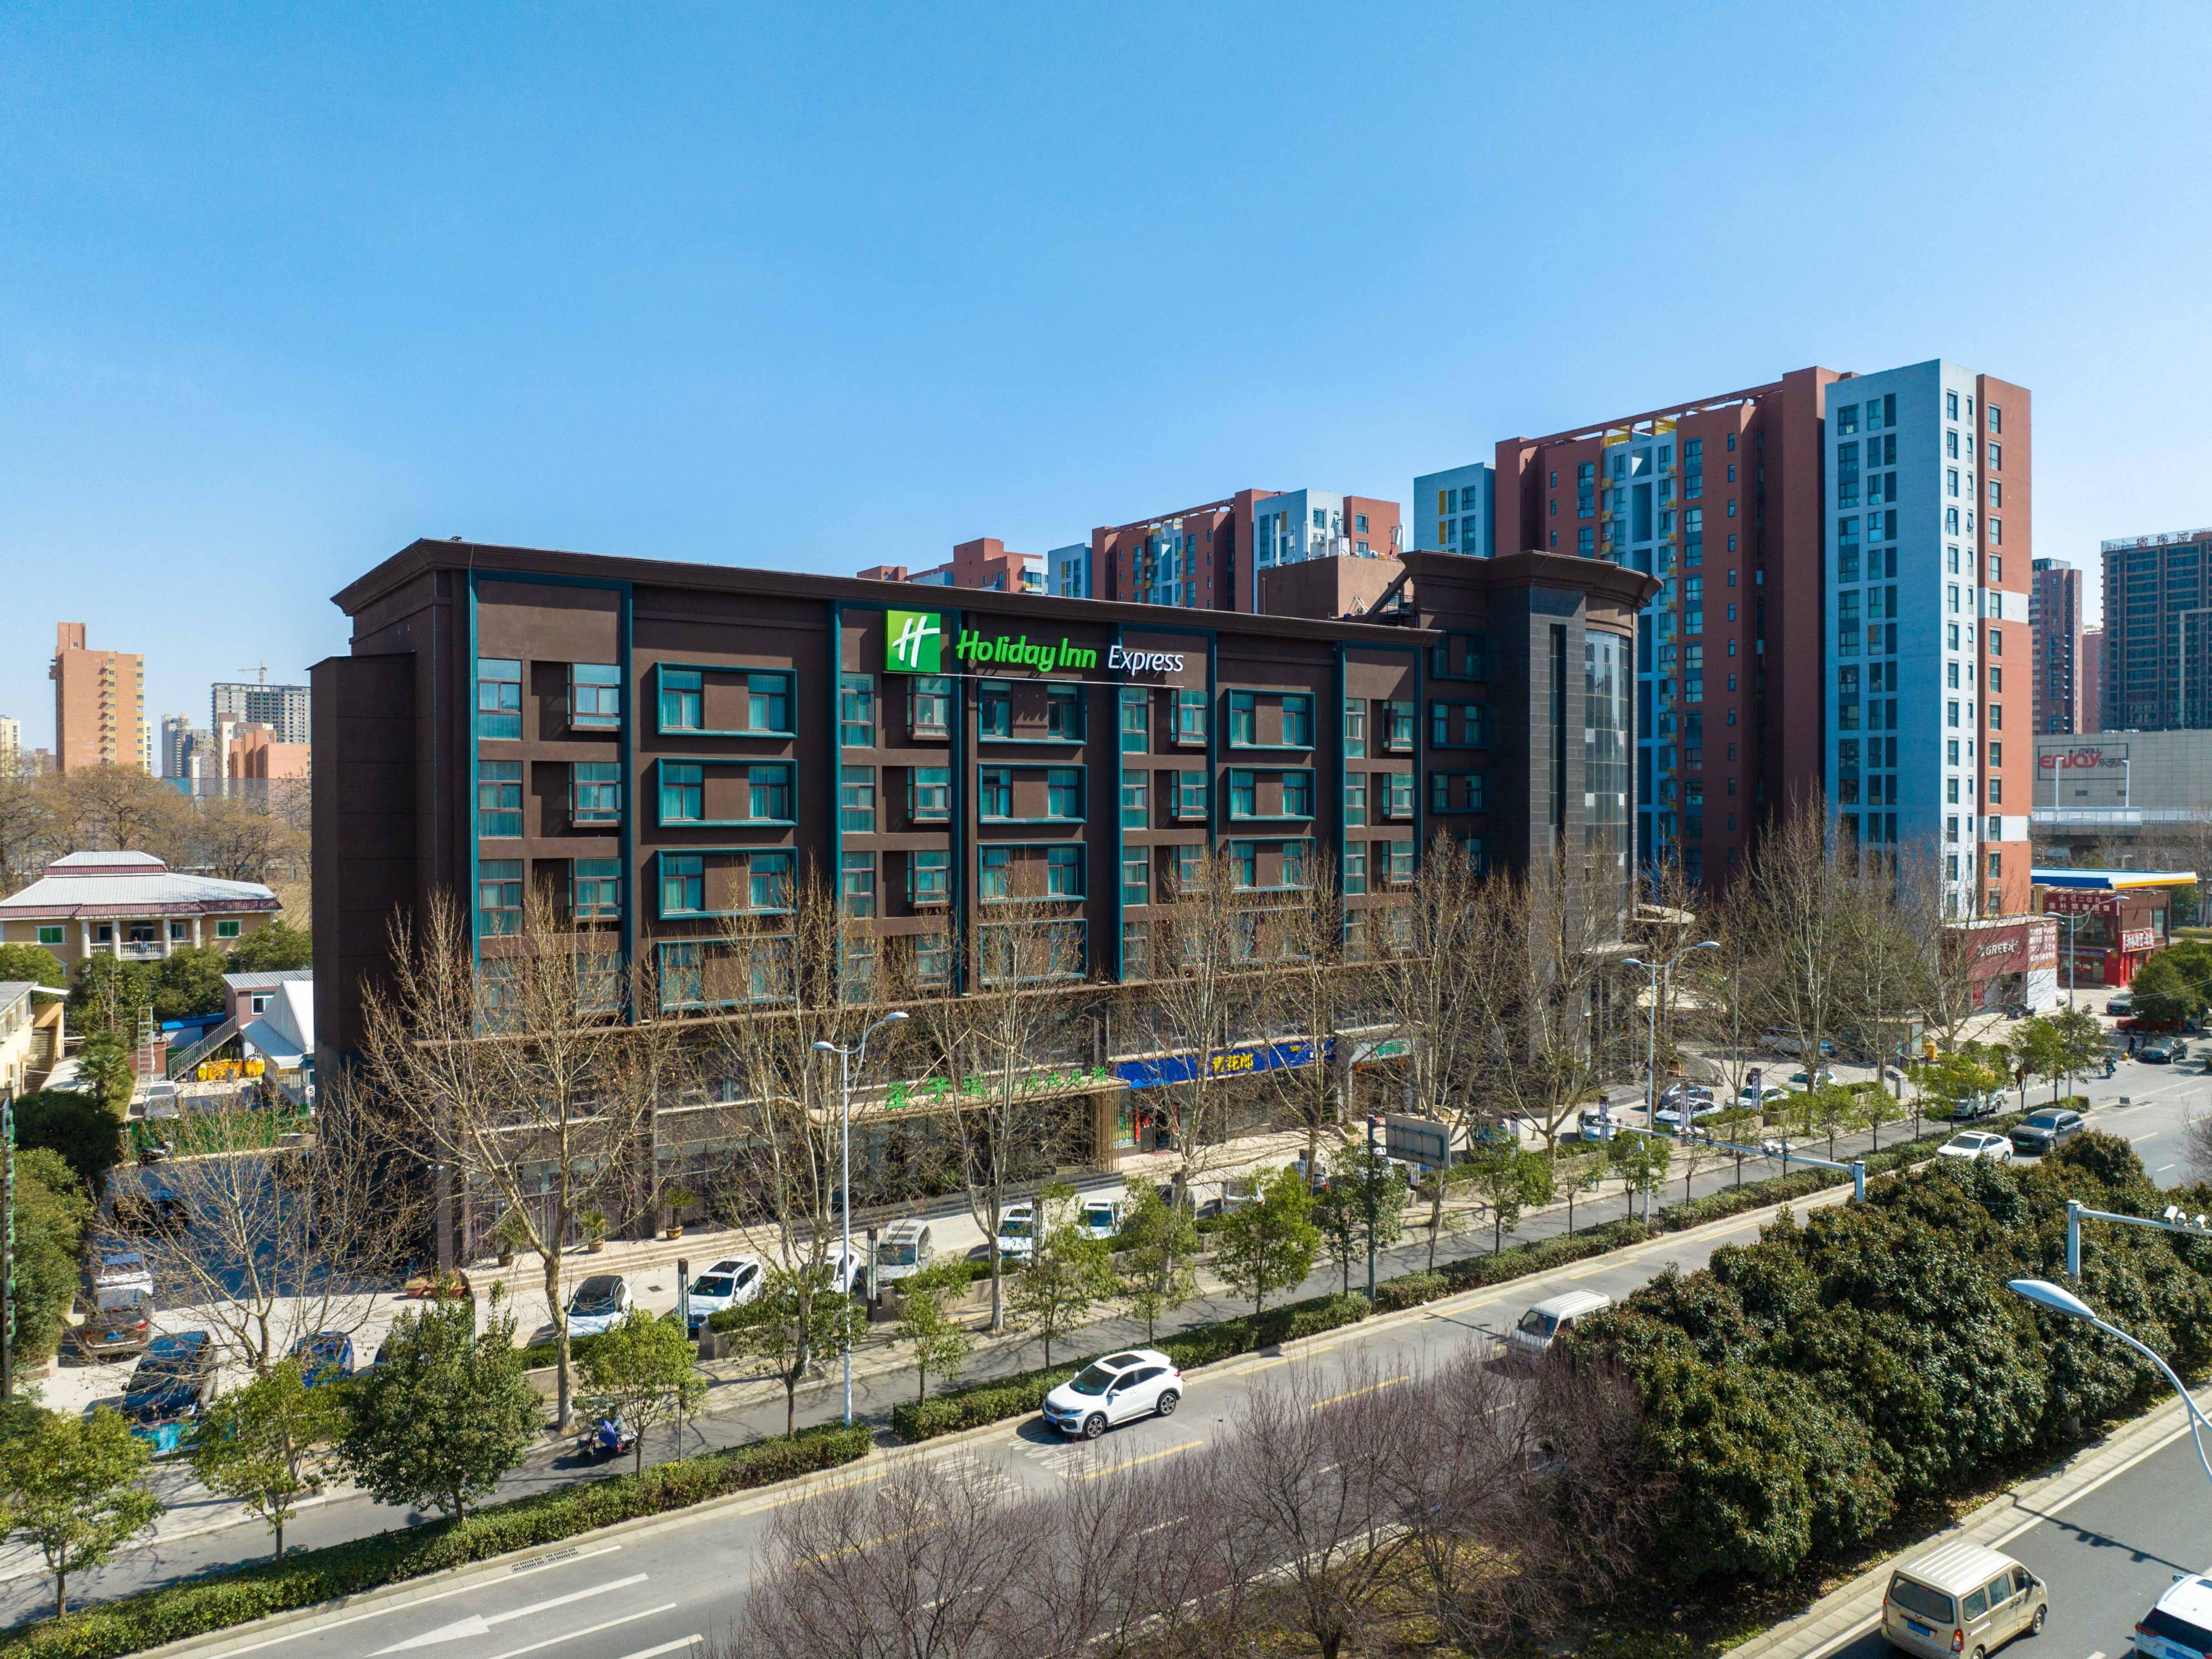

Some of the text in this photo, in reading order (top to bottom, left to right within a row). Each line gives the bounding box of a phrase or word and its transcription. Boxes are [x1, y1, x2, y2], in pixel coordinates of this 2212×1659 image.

[956, 629, 1185, 676] Holiday Inn Express
[1985, 943, 2008, 956] GREE
[1213, 1052, 1254, 1073] 青花郎
